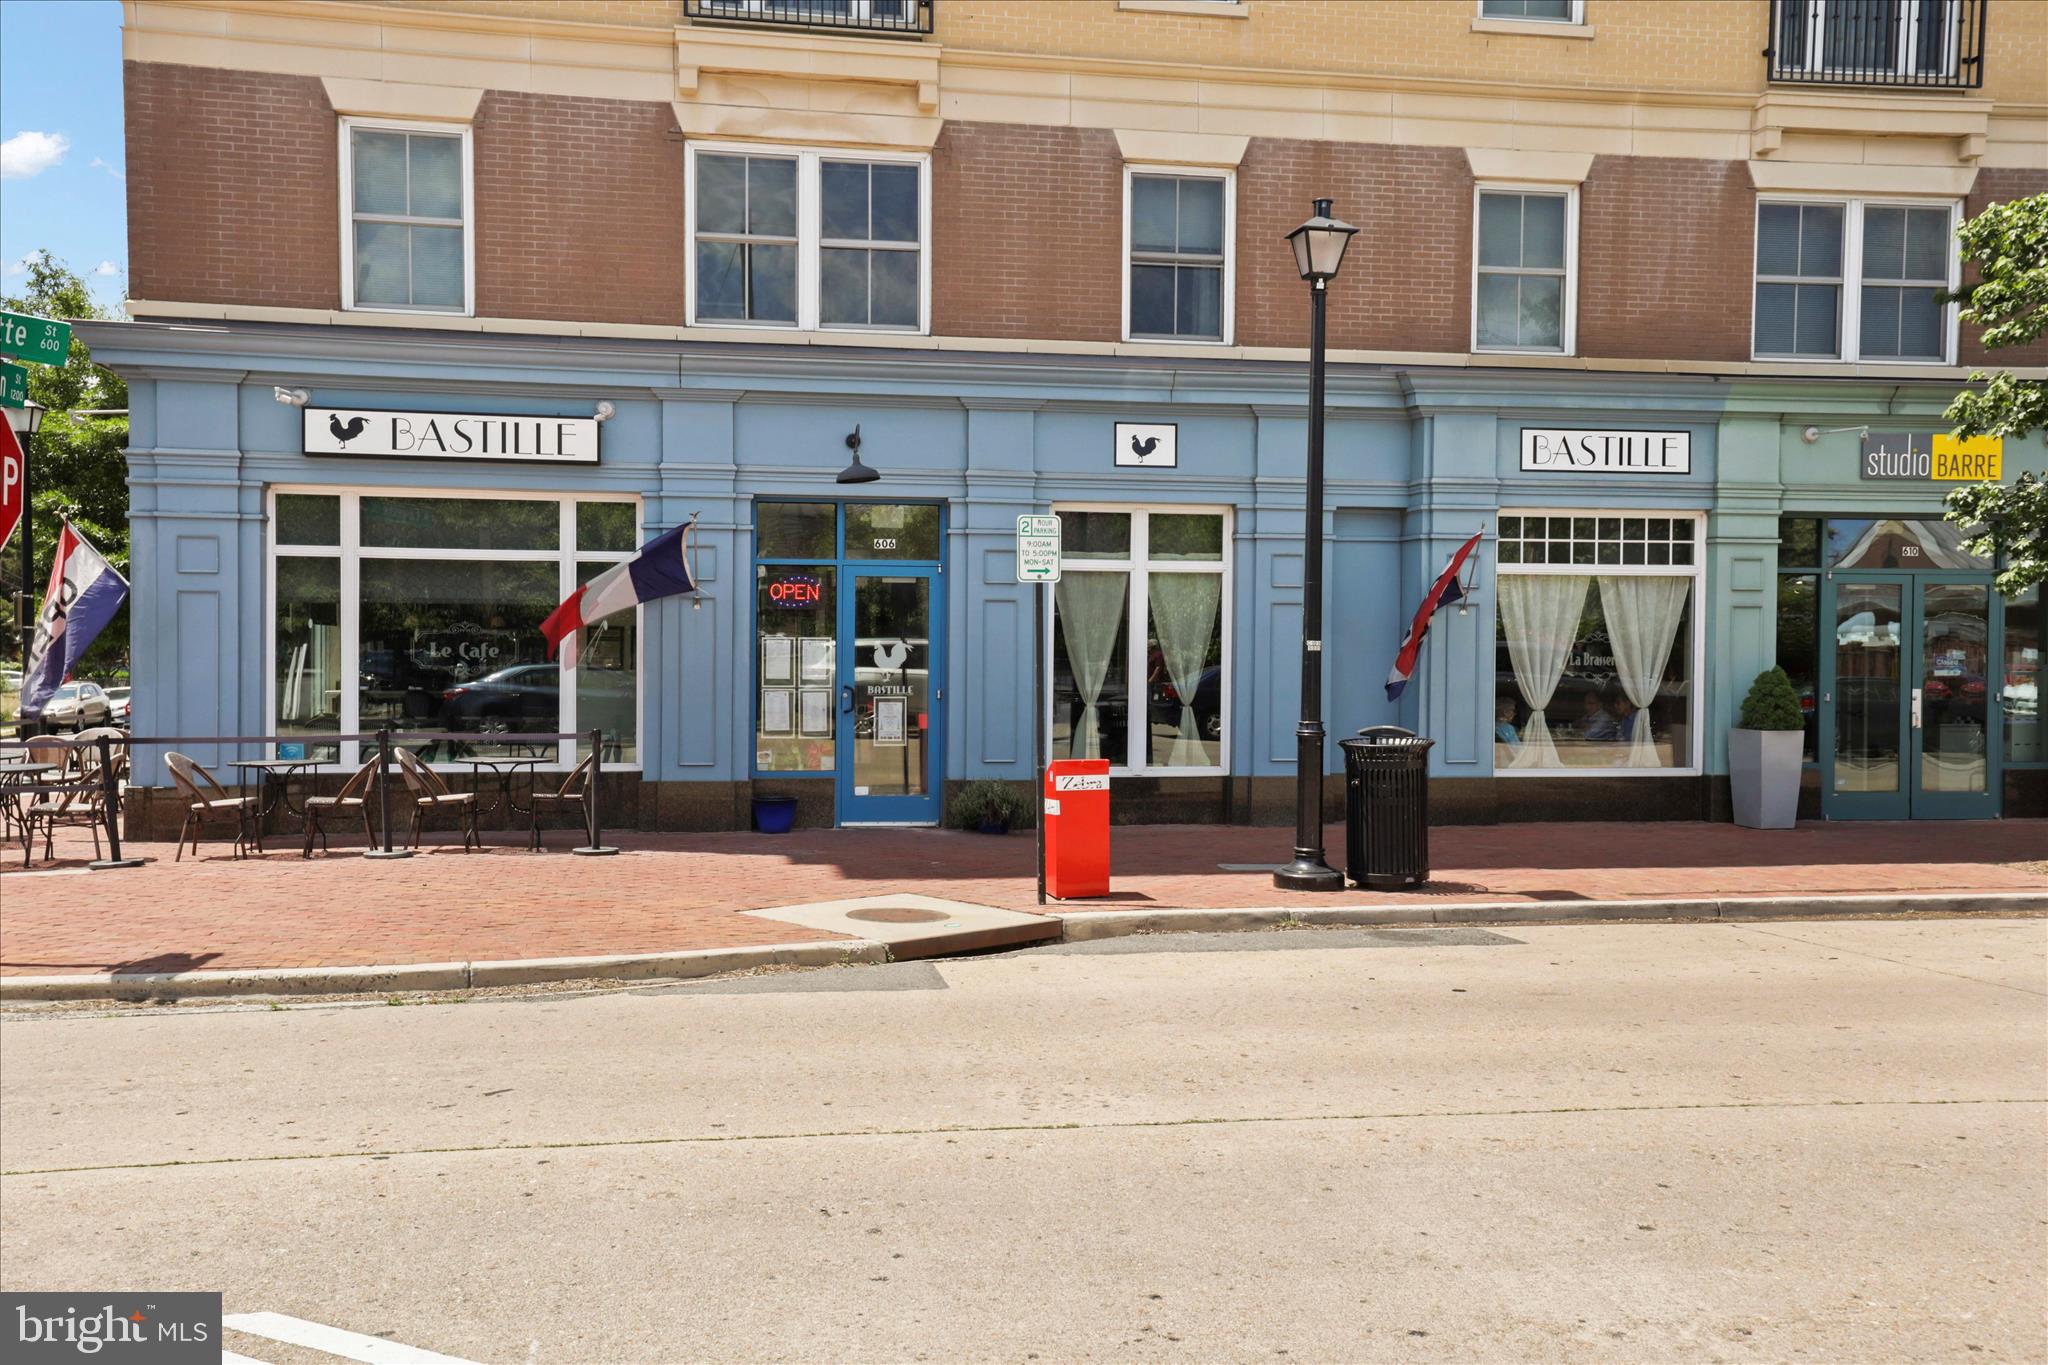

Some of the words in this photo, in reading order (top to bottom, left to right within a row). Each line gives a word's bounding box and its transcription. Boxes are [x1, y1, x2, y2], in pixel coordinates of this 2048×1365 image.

[45, 325, 57, 337] St
[40, 339, 60, 352] 600
[15, 373, 22, 385] St
[10, 389, 24, 402] 1200
[391, 417, 577, 456] BASTILLE
[1533, 435, 1678, 467] BASTILLE
[1867, 433, 1930, 477] studio
[1937, 454, 1997, 478] BARRE
[1021, 521, 1030, 533] 2
[874, 539, 896, 549] 606
[1903, 547, 1918, 556] 610
[769, 583, 820, 601] OPEN
[429, 642, 452, 659] Le
[458, 641, 500, 662] Cafe
[1570, 654, 1581, 666] La
[867, 685, 914, 695] BASTILLE
